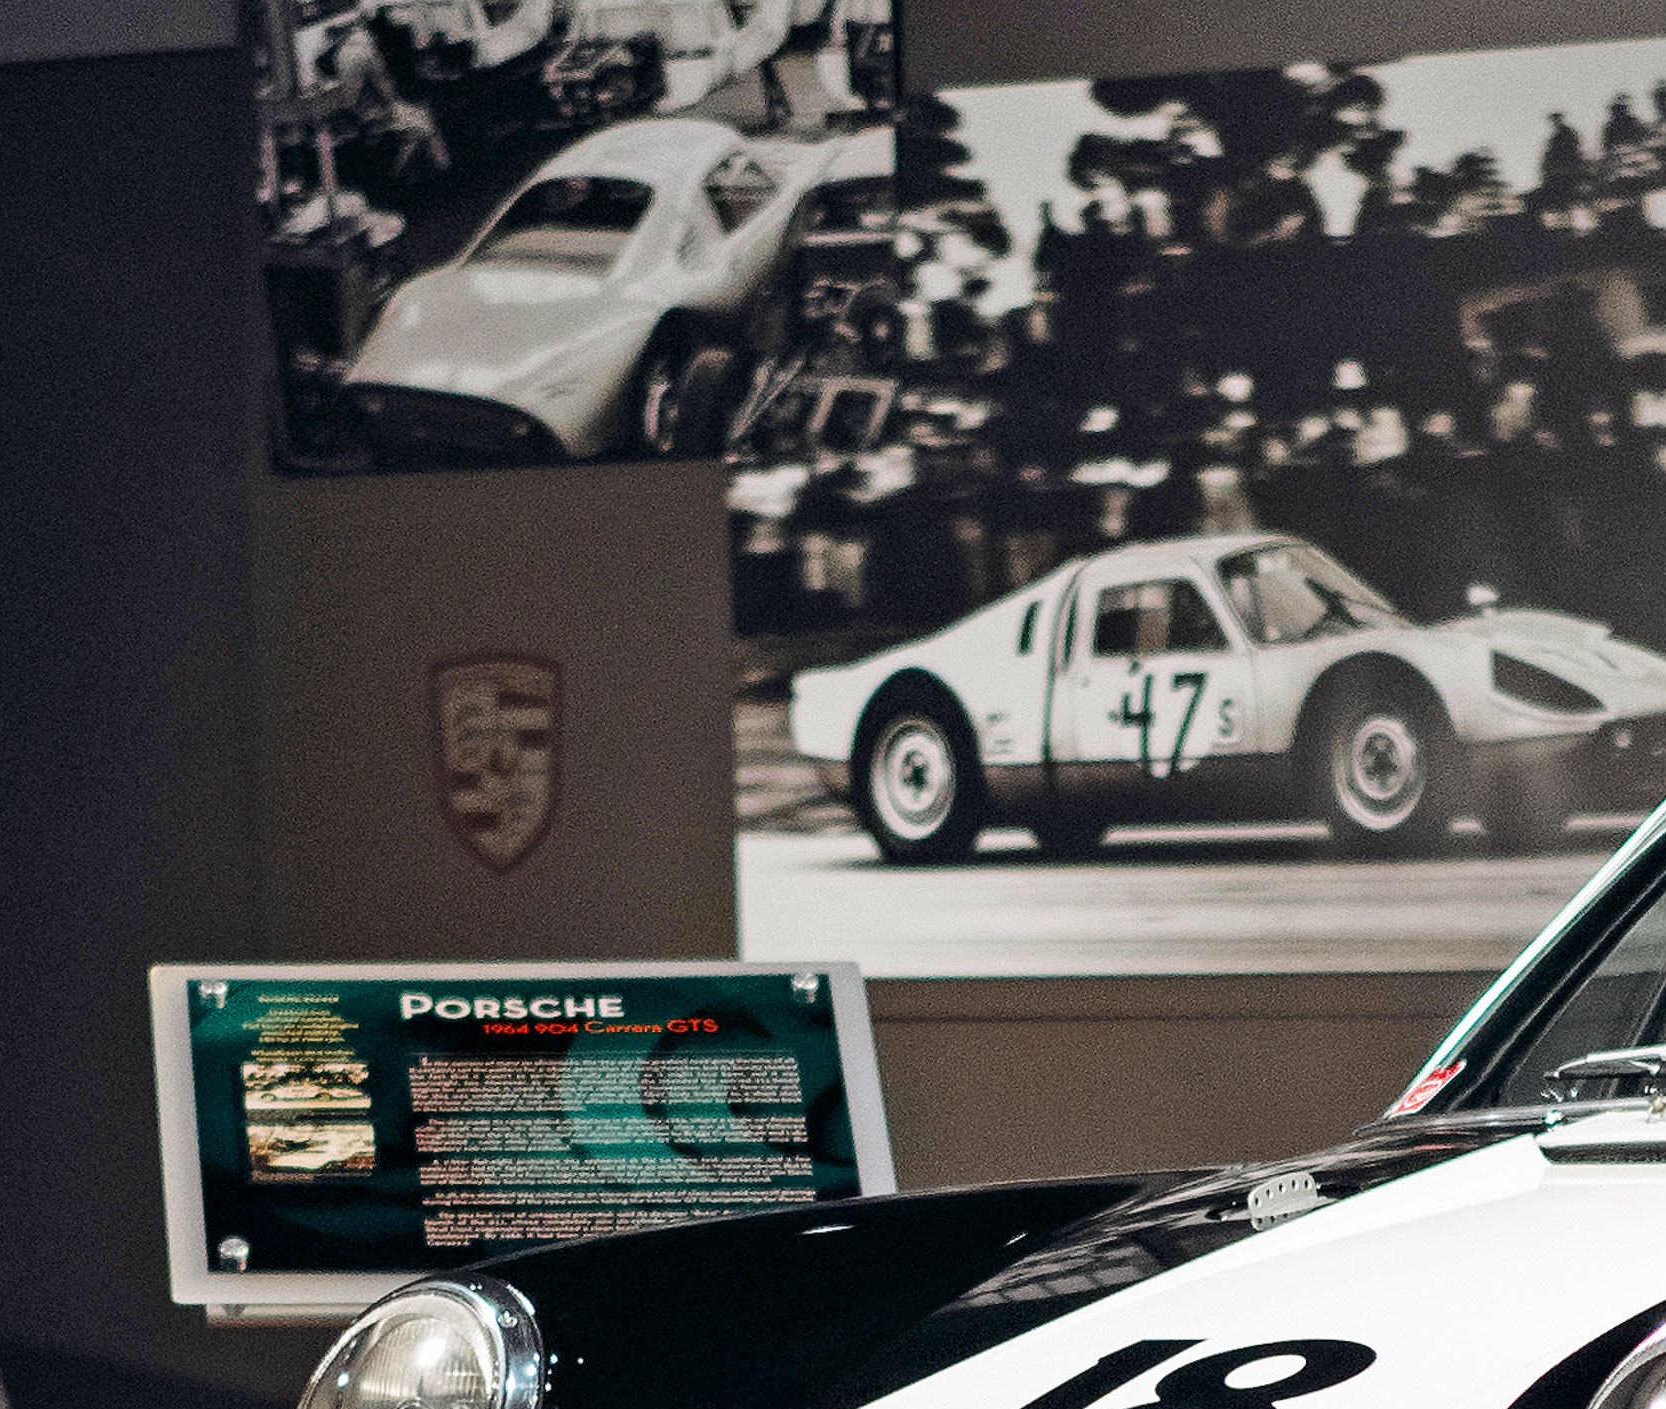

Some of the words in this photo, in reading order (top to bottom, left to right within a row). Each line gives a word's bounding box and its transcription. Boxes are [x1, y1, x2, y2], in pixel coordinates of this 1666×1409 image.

[1108, 672, 1208, 771] 47
[401, 992, 625, 1019] PORSCHE
[483, 1022, 529, 1034] 1964
[534, 1022, 579, 1034] 904
[584, 1020, 663, 1034] Carrera
[666, 1018, 719, 1033] GTS
